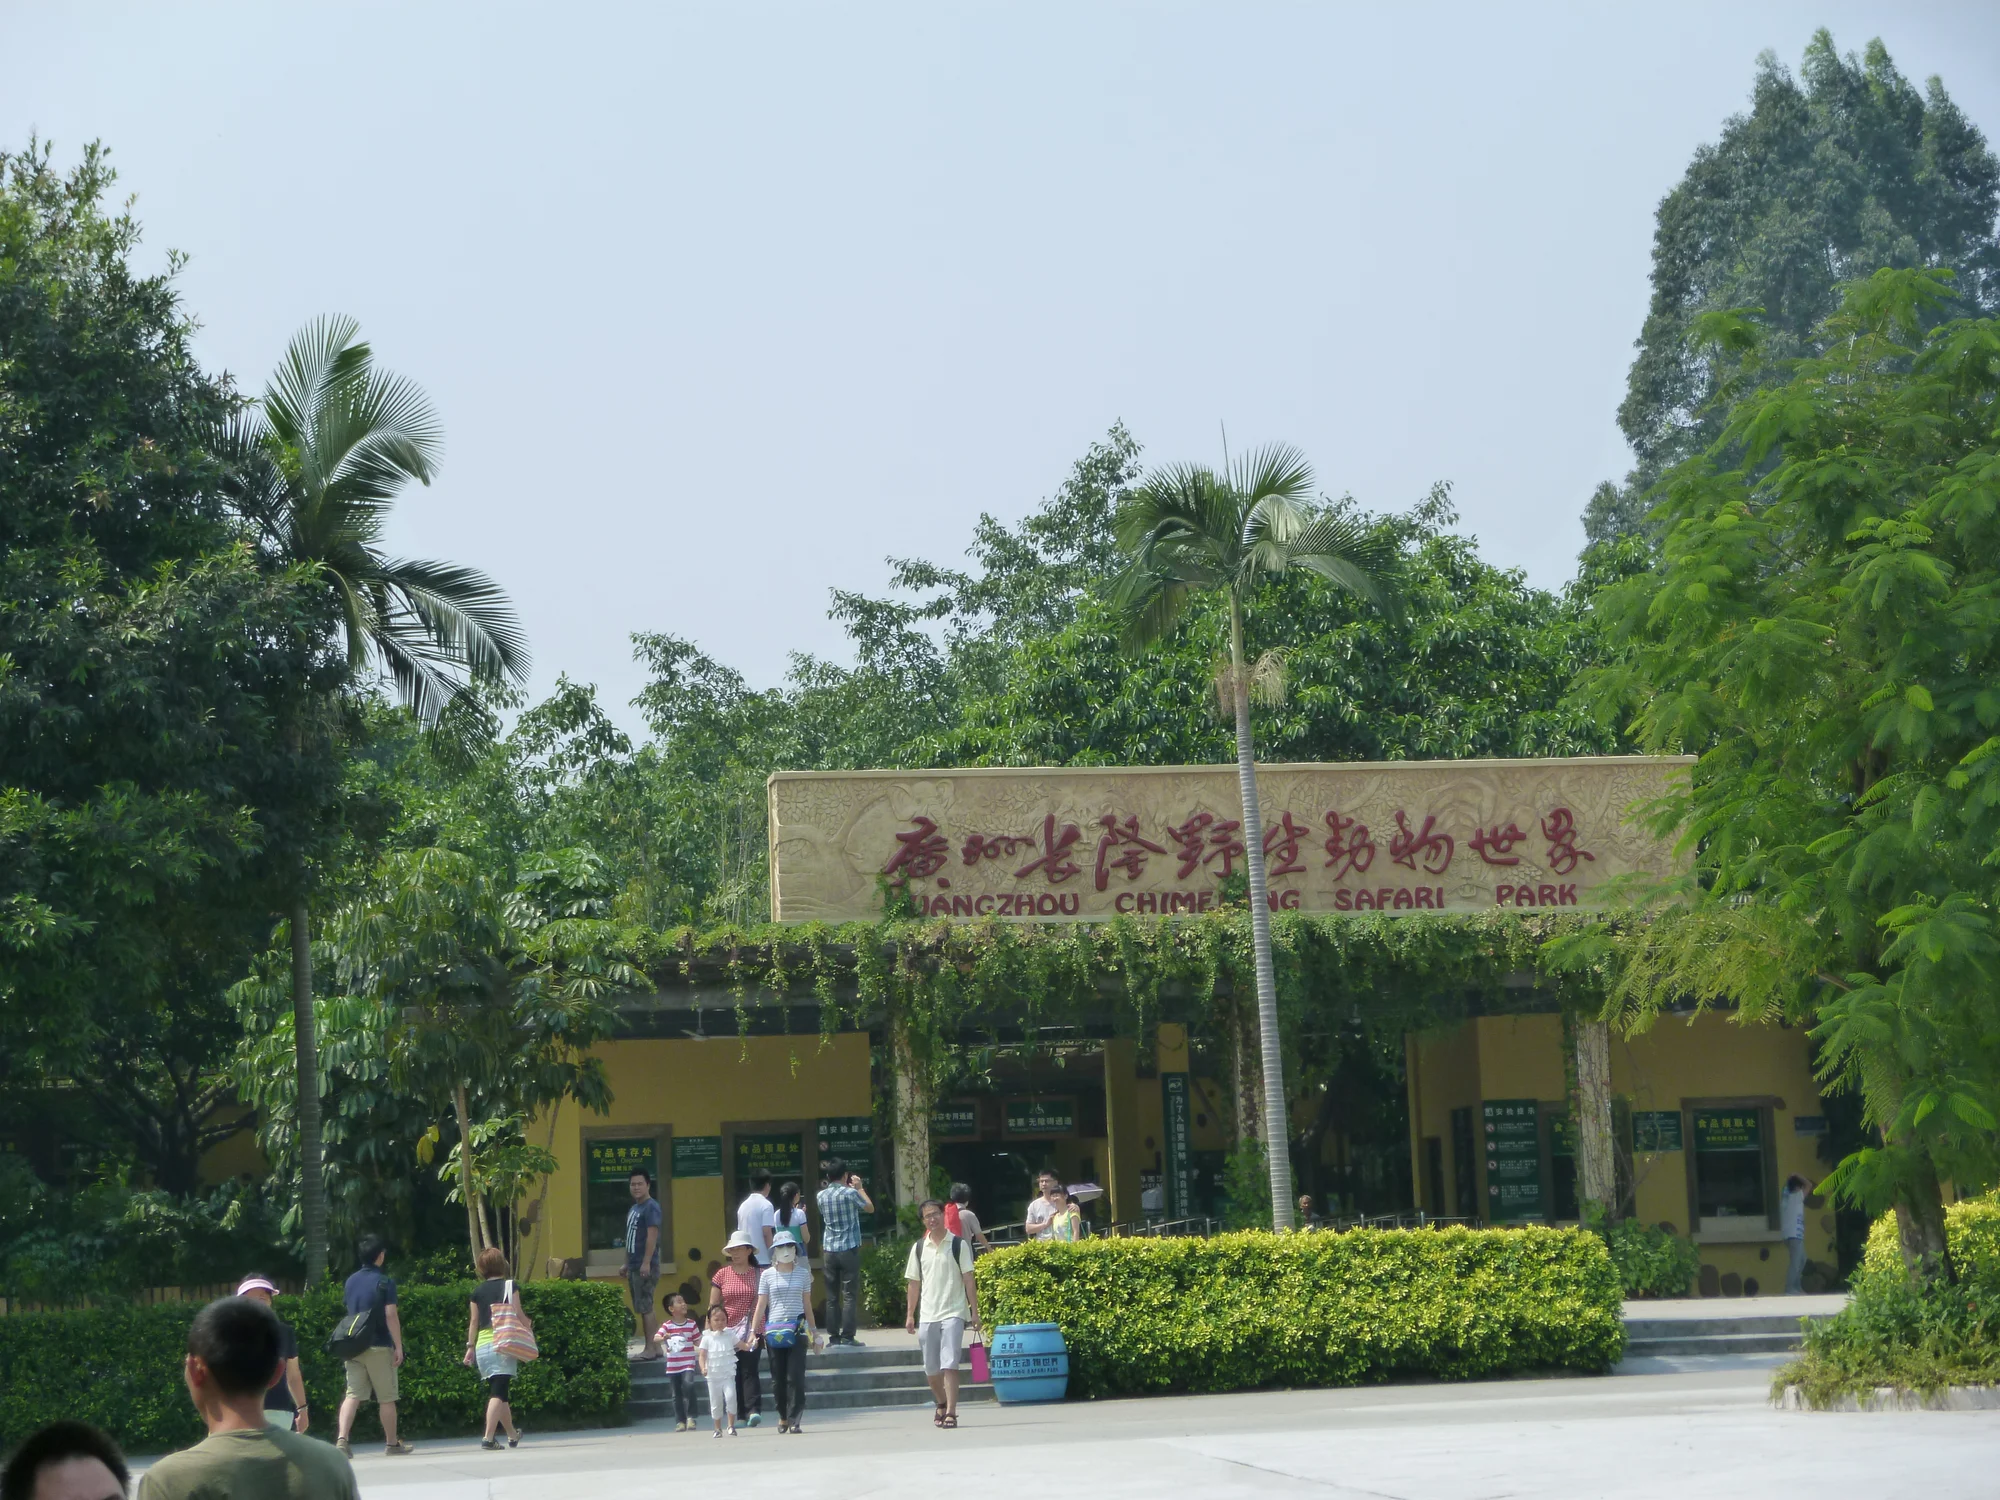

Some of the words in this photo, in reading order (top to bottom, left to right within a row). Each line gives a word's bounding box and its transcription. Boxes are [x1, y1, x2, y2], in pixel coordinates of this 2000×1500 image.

[891, 893, 1080, 917] UANGZHOU
[1114, 890, 1300, 914] CHIMENG
[1334, 886, 1445, 911] SAFARI
[1496, 883, 1578, 906] PARK
[592, 1147, 652, 1158] 食品寄存处
